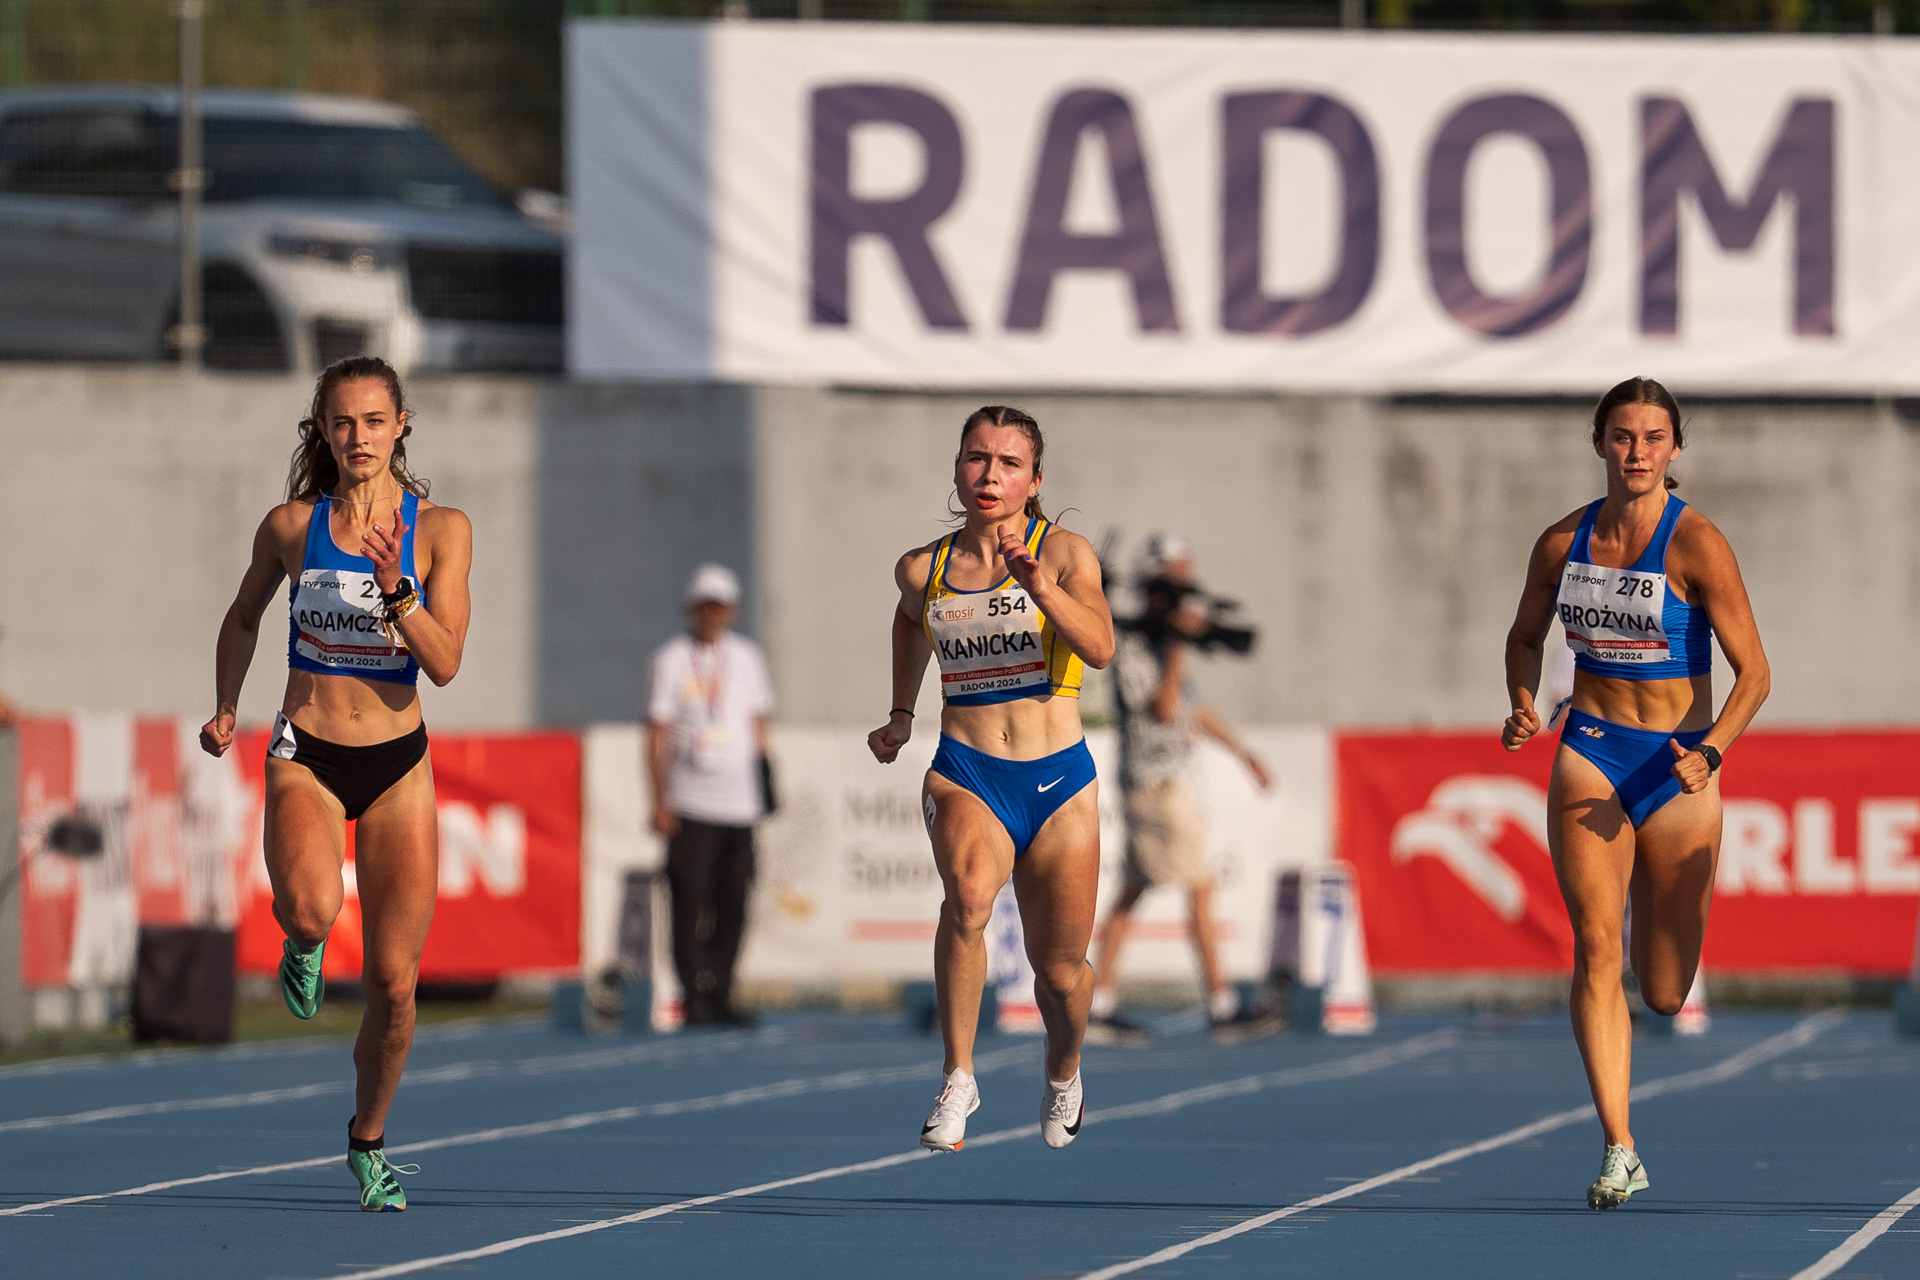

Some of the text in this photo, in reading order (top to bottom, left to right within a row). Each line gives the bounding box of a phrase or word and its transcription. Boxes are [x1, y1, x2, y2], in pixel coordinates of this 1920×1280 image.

[807, 83, 1839, 338] RADOM
[320, 581, 347, 590] SPORT
[1566, 573, 1606, 586] TVP SPORT
[1615, 576, 1654, 598] 278
[945, 605, 975, 620] mosir
[987, 596, 1027, 617] 554
[301, 609, 387, 633] ADAMCZ
[1560, 603, 1660, 633] BROŻYNA
[326, 646, 365, 654] Mistrzostwa
[366, 647, 384, 655] Polski
[938, 630, 1038, 661] KANICKA
[317, 652, 382, 667] RADOM 2024
[1619, 652, 1643, 660] 2024
[967, 670, 1004, 679] Mistrzostwa
[1004, 666, 1022, 675] Polski
[1023, 664, 1036, 672] U20
[960, 677, 1021, 692] RADOM 2024
[1717, 796, 1920, 896] RLE
